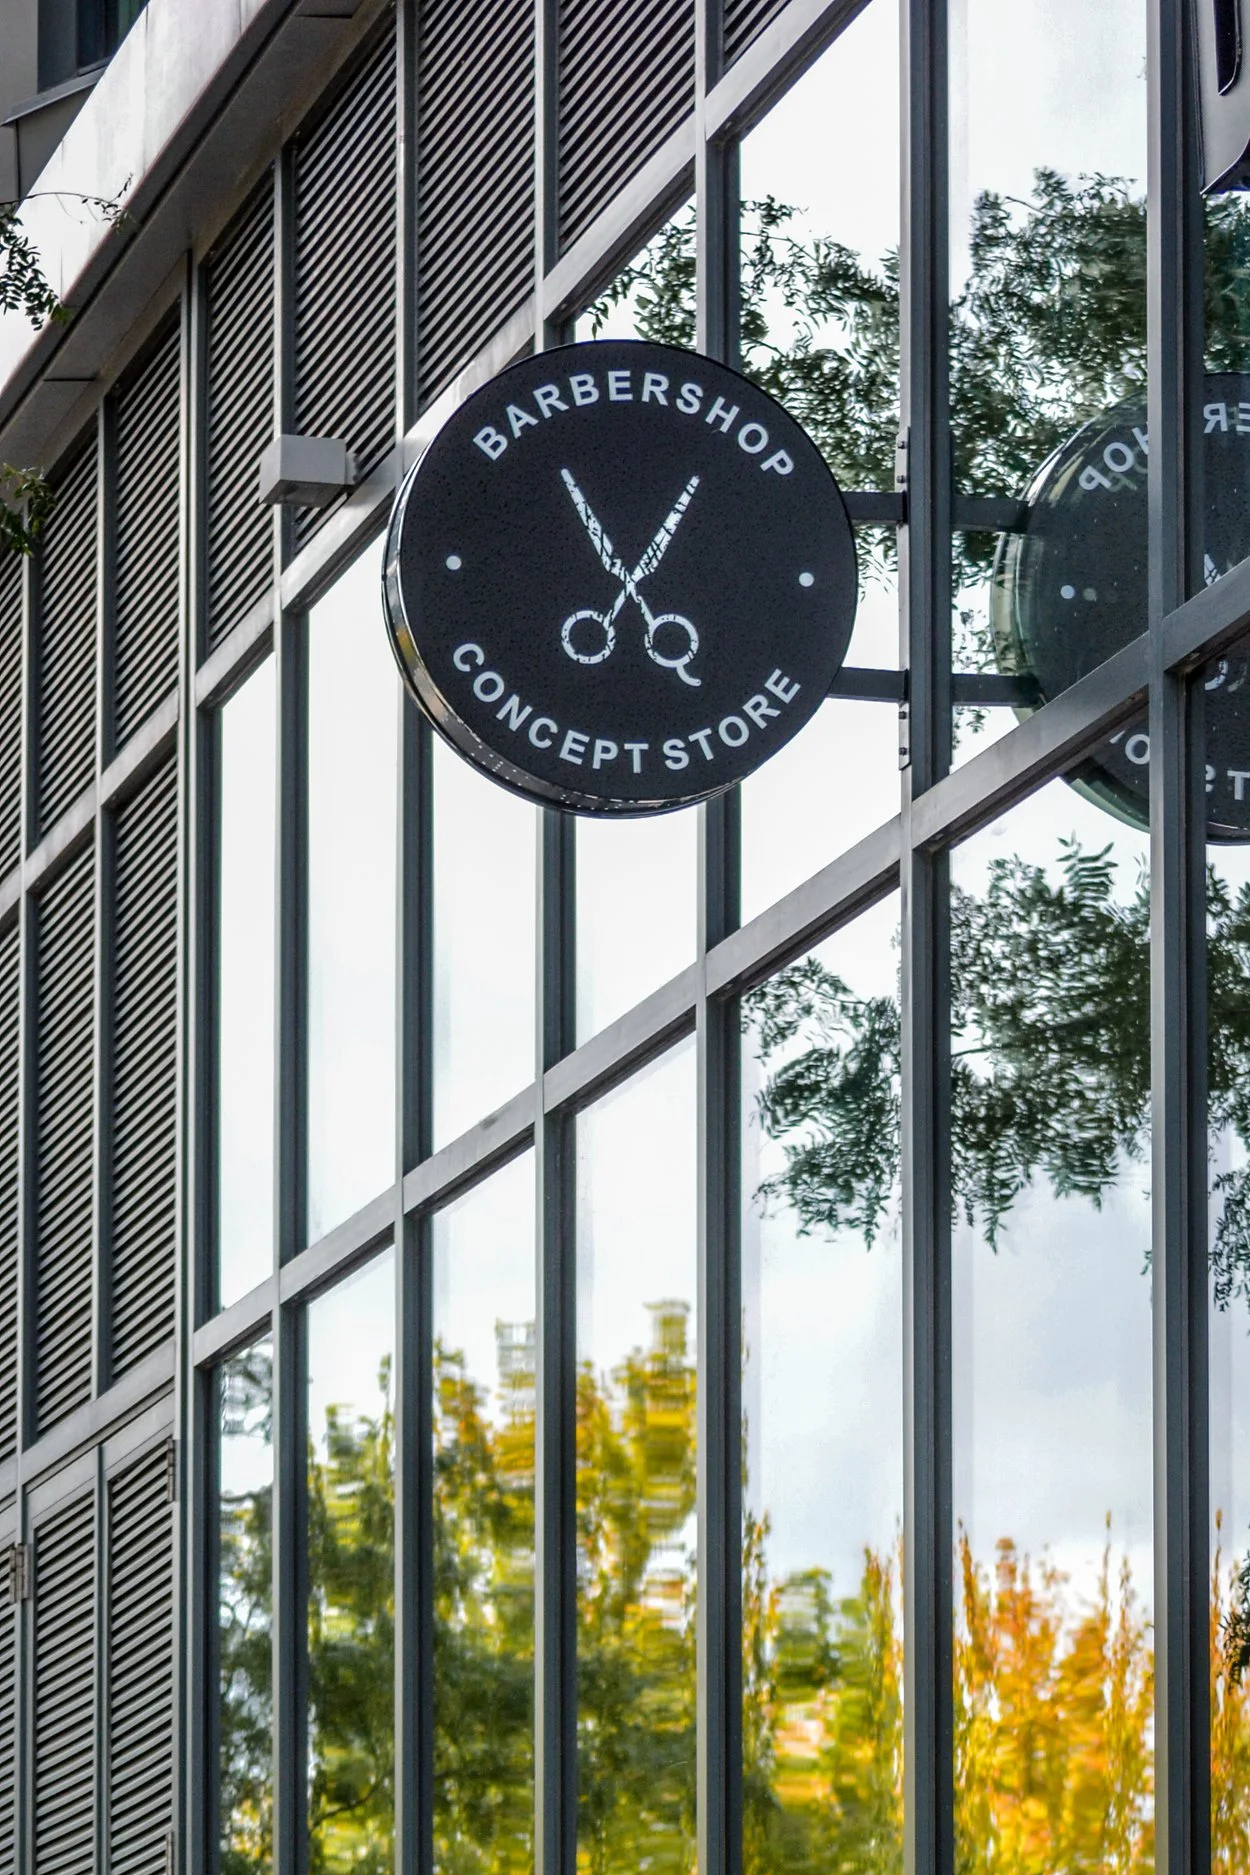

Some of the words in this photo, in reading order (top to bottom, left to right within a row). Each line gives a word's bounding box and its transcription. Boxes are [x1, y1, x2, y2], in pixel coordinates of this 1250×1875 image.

[472, 370, 795, 476] BARBERSHOP
[452, 642, 650, 774] CONCEPT
[662, 668, 802, 771] STORE
